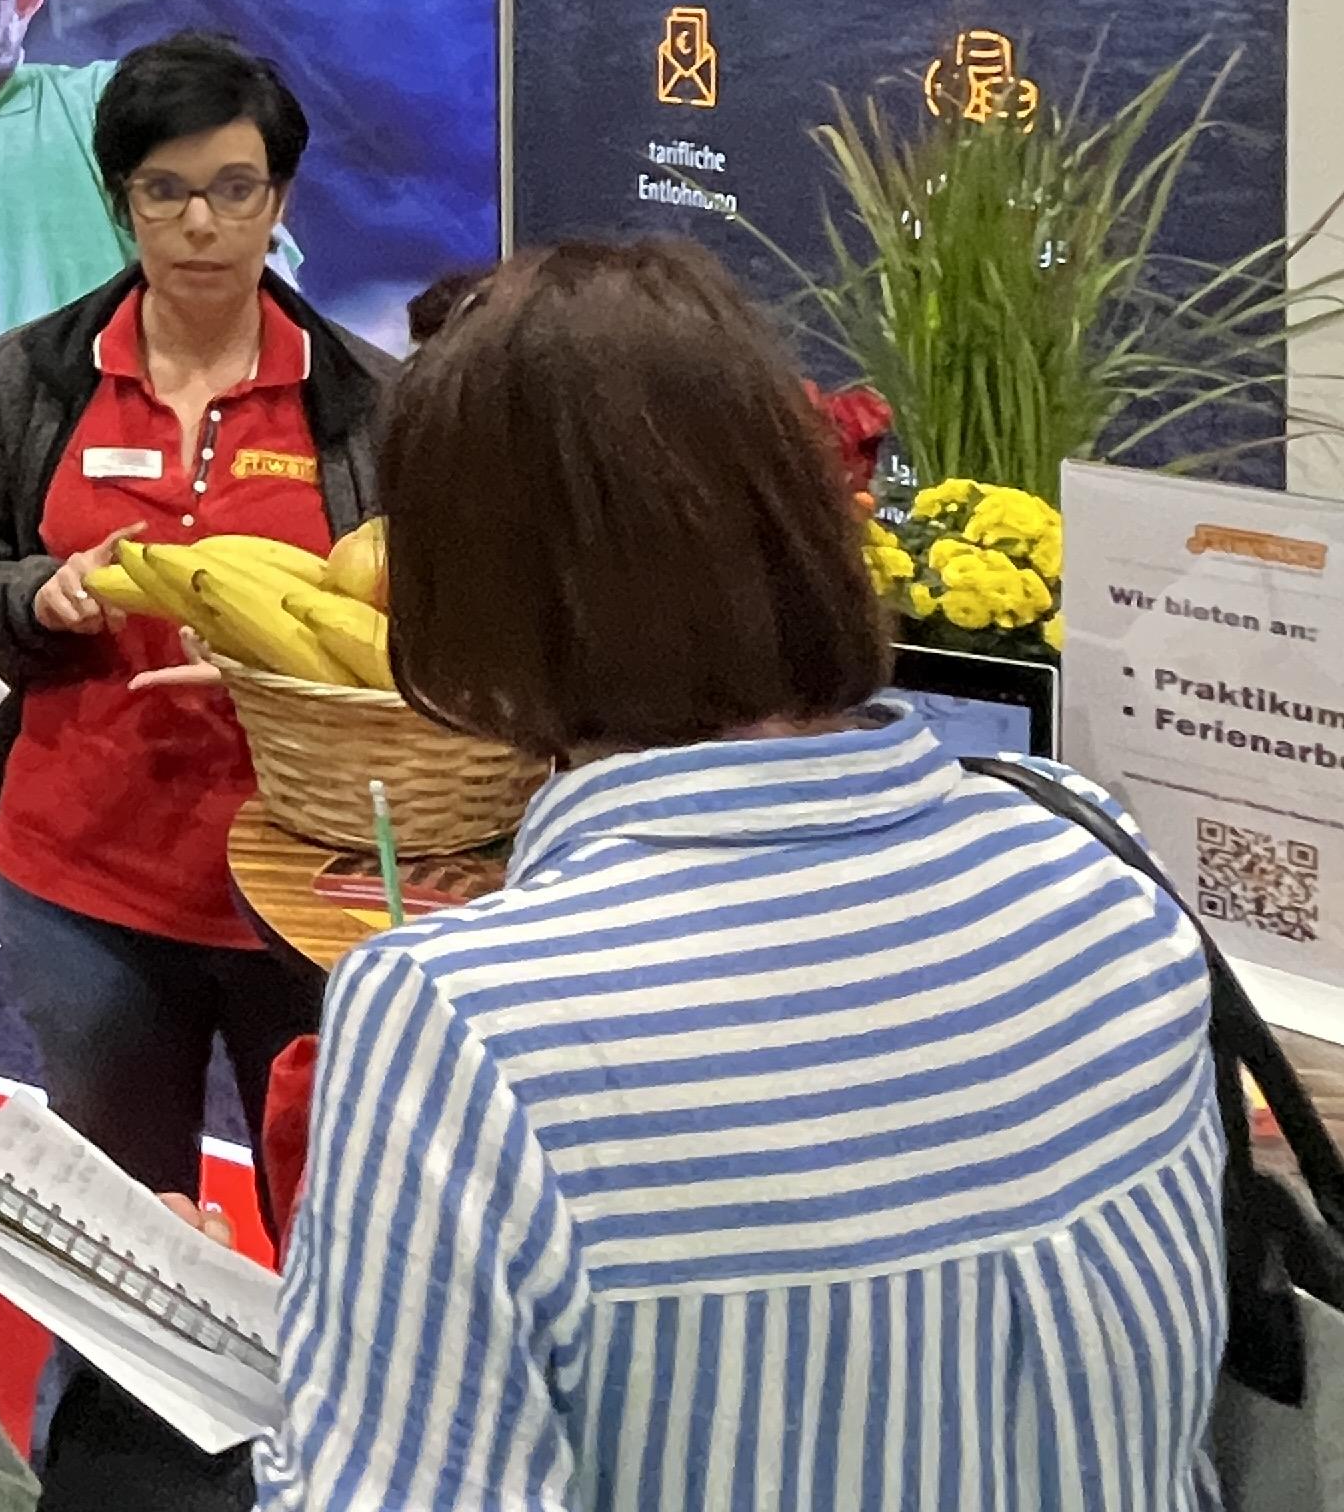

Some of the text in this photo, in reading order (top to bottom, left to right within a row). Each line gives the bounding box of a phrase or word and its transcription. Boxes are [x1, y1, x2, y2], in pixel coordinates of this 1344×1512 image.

[648, 141, 726, 172] tarifliche
[1109, 585, 1319, 642] Wir bieten an:
[1155, 708, 1344, 768] Ferienarb
